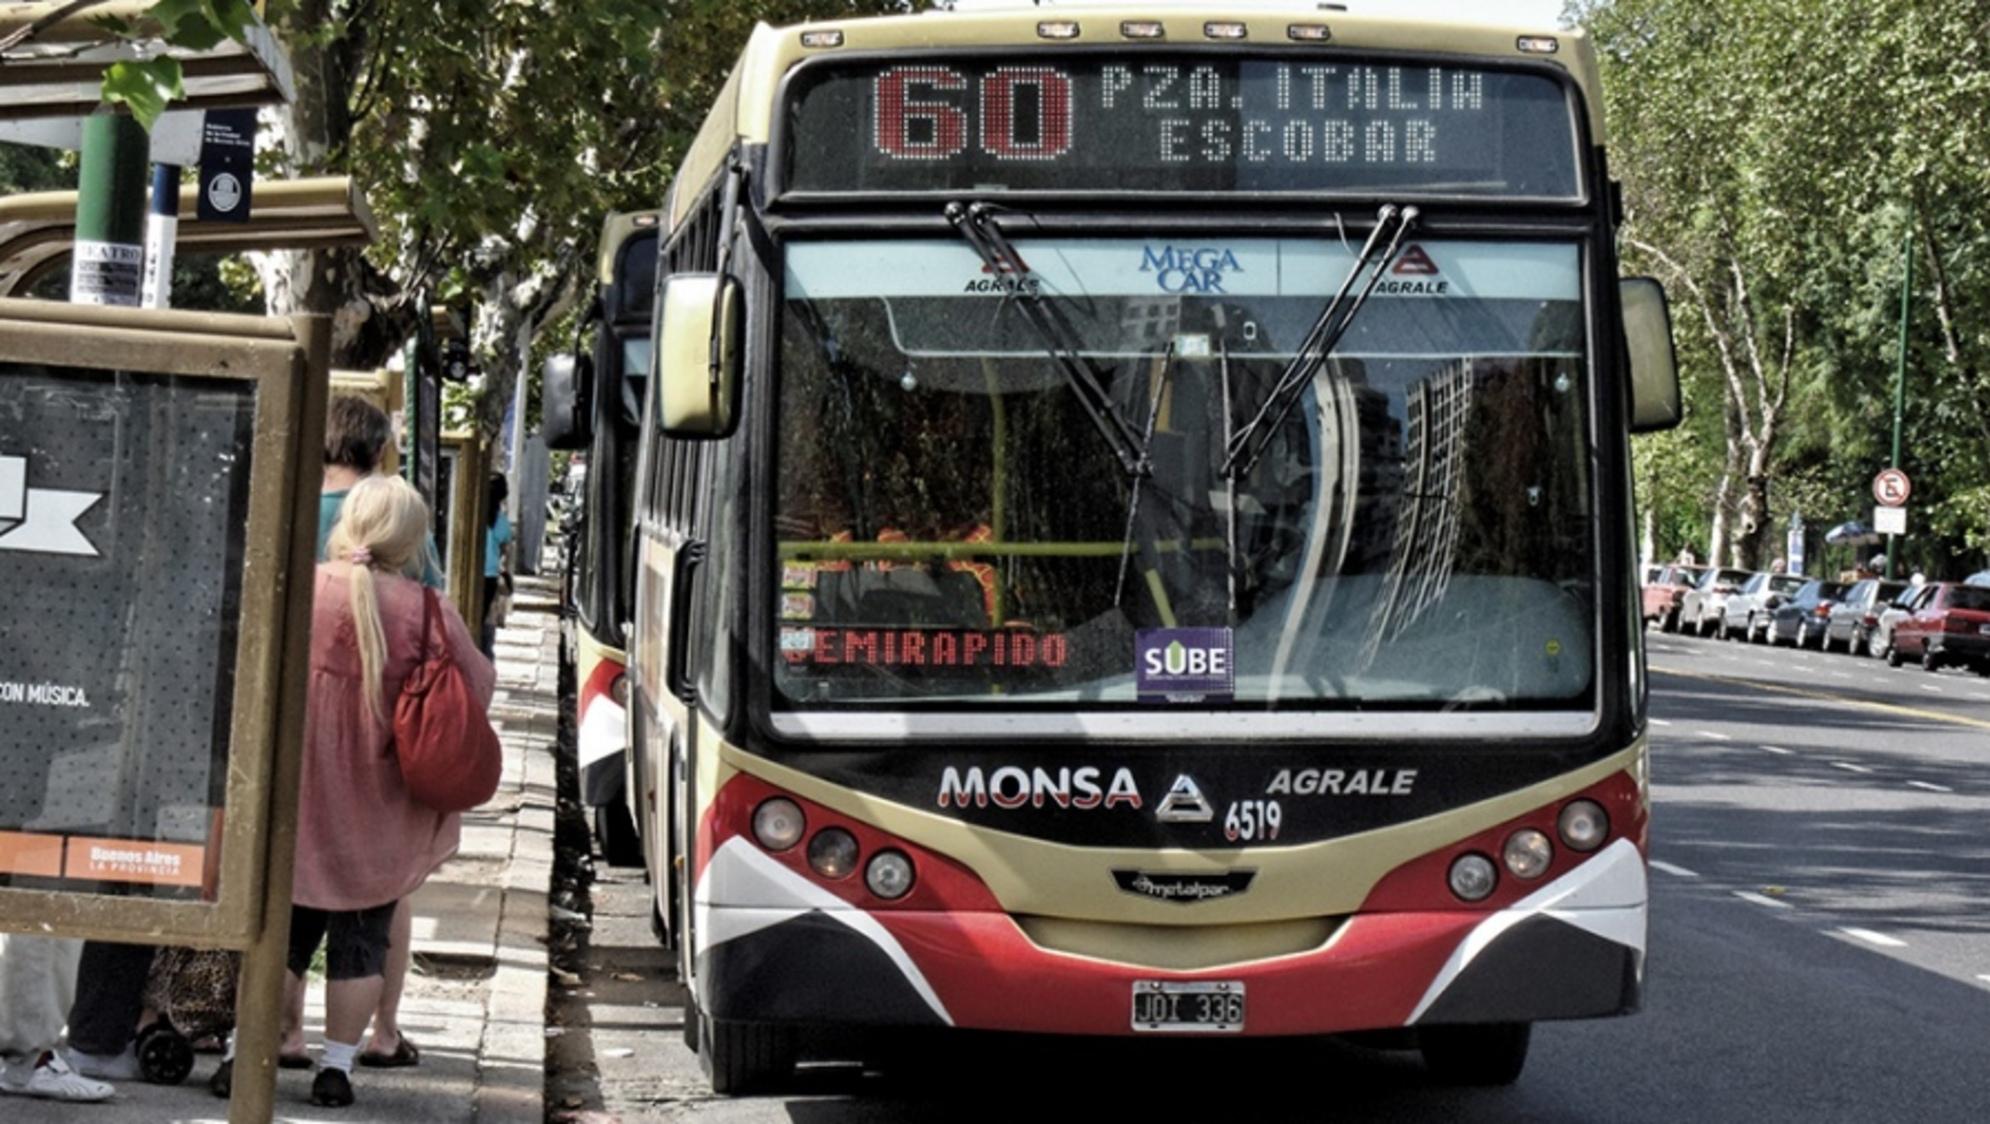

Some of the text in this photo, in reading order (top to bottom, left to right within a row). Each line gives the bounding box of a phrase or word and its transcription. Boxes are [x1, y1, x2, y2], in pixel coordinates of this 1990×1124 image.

[1102, 66, 1243, 109] PZA.
[873, 65, 1073, 160] 60
[1160, 119, 1436, 162] ESCOBAR
[81, 245, 140, 260] EATRO
[1139, 245, 1244, 271] MEGA
[1156, 269, 1228, 293] CAR
[1375, 281, 1449, 294] AGRALE
[1145, 647, 1226, 674] SUBE
[28, 681, 90, 707] MÚSICA.
[937, 765, 1142, 810] MONSA
[1266, 769, 1418, 796] AGRALE
[1224, 801, 1281, 840] 6519
[91, 848, 142, 863] Buenos
[1196, 994, 1242, 1023] 336
